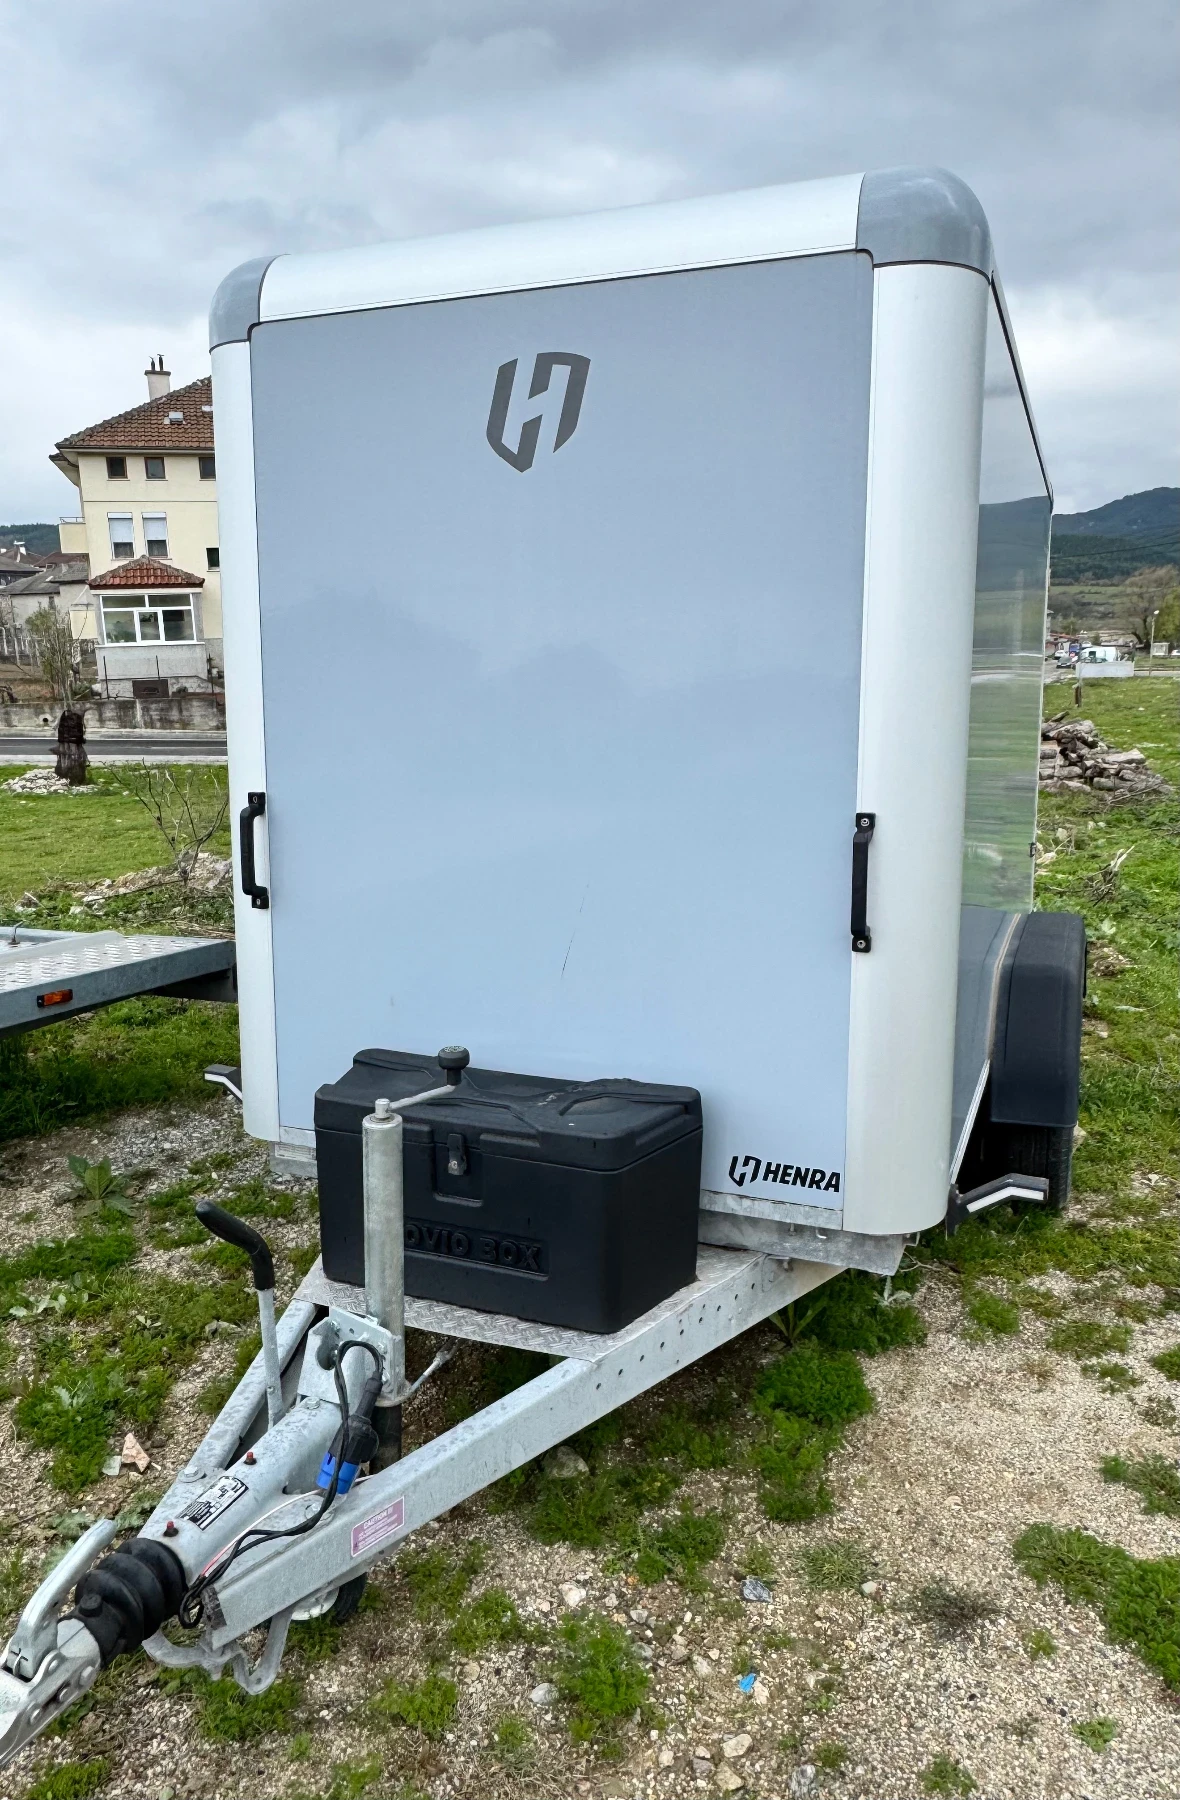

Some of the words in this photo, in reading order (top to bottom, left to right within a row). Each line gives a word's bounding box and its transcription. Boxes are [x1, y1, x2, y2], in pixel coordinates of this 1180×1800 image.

[762, 1162, 841, 1193] HENRA
[403, 1223, 469, 1256] OVIO
[480, 1237, 541, 1271] BOX
